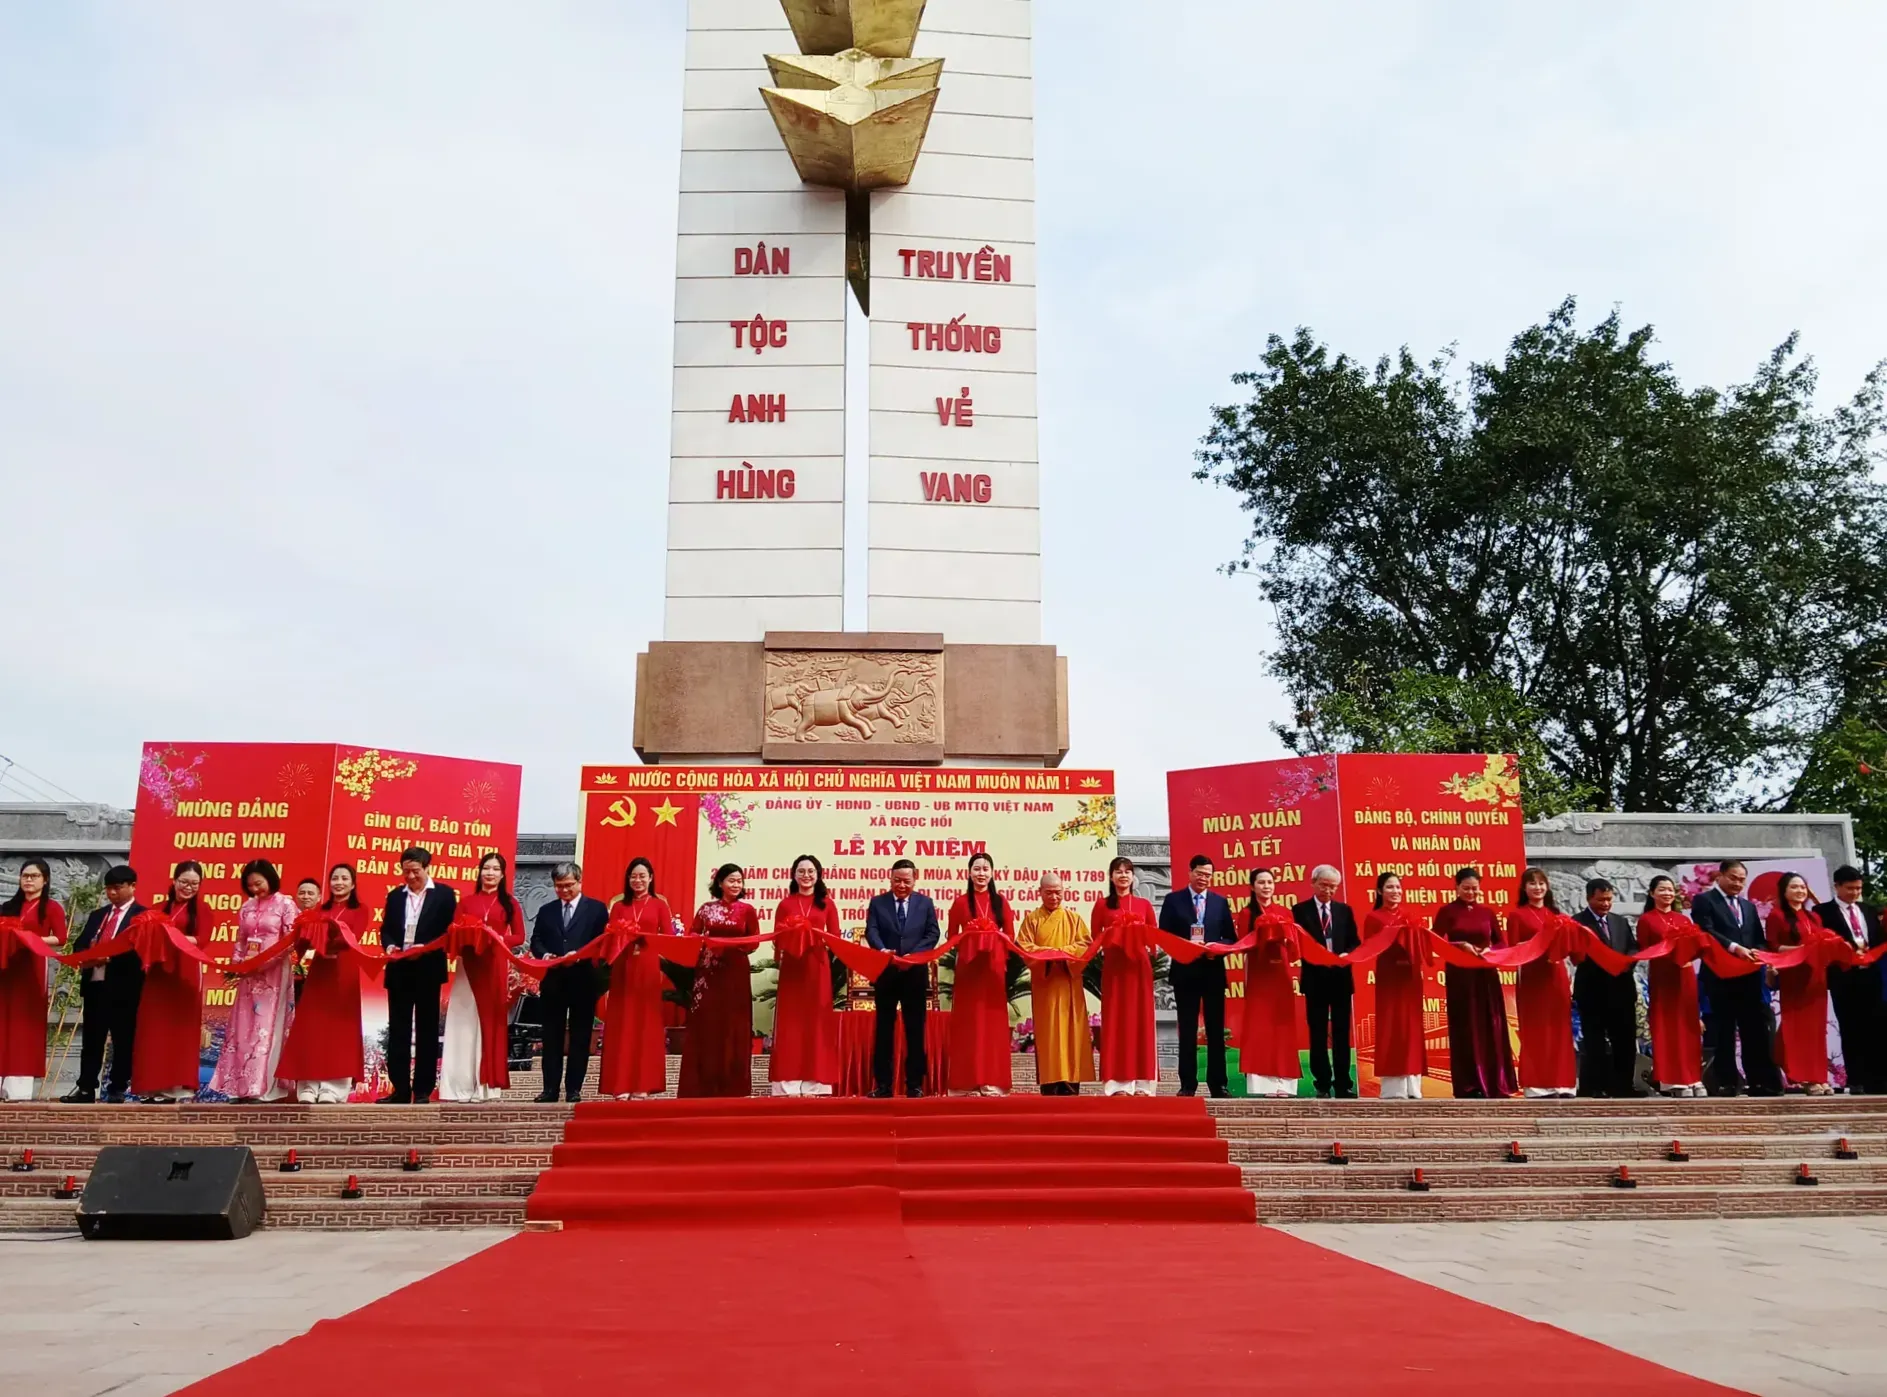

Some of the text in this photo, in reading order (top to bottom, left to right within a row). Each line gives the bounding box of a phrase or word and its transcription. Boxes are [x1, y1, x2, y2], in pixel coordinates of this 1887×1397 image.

[734, 241, 790, 275] DÂN
[898, 245, 1011, 282] TRUYỀN
[730, 314, 787, 354] TỘC
[907, 313, 1001, 353] THỐNG
[728, 394, 785, 423] ANH
[936, 387, 973, 427] VẺ
[717, 461, 795, 499] HÙNG
[920, 471, 992, 502] VANG
[628, 769, 671, 787] NƯỚC
[676, 769, 718, 790] CỘNG
[723, 769, 754, 787] HÒA
[758, 770, 779, 787] XÃ
[784, 770, 809, 790] HỘI
[814, 768, 844, 787] CHỦ
[849, 771, 896, 788] NGHĨA
[900, 771, 931, 791] VIỆT
[936, 774, 971, 789] NAM
[975, 772, 1020, 790] MUÔN
[1025, 772, 1060, 790] NĂM
[176, 797, 289, 818] MỪNG ĐẢNG
[885, 800, 920, 811] UBND
[933, 801, 950, 811] UB
[955, 801, 989, 812] MTTQ
[993, 800, 1020, 814] VIỆT
[1023, 802, 1054, 812] NAM
[1354, 806, 1392, 824] ĐẢNG
[1421, 809, 1462, 824] CHÍNH
[364, 811, 392, 828] GÌN
[429, 816, 459, 834] BẢO
[869, 814, 887, 827] XÃ
[890, 817, 926, 829] NGỌC
[1203, 808, 1302, 833] MÙA XUÂN
[174, 832, 285, 849] QUANG VINH
[347, 833, 367, 850] VÀ
[372, 837, 411, 853] PHÁT
[448, 842, 472, 858] GIÁ
[833, 833, 987, 860] LỄ KỶ NIỆM
[1223, 834, 1282, 859] LÀ TẾT
[1391, 834, 1481, 851] VÀ NHÂN DÂN
[357, 856, 388, 875] BẢN
[428, 864, 457, 880] VĂN
[461, 867, 479, 882] HÓ
[821, 863, 856, 880] HẮNG
[924, 866, 952, 880] MÙA
[994, 865, 1009, 881] KỶ
[1013, 867, 1038, 884] DẬU
[1075, 870, 1105, 882] 1789
[1269, 862, 1306, 883] CÂY
[1355, 860, 1373, 877] XÃ
[1377, 863, 1414, 881] NGỌC
[1488, 861, 1516, 878] TÂM
[840, 885, 875, 903] NHẬN
[1084, 890, 1104, 902] GIA
[1406, 887, 1509, 907] HIỆN THG LỢI
